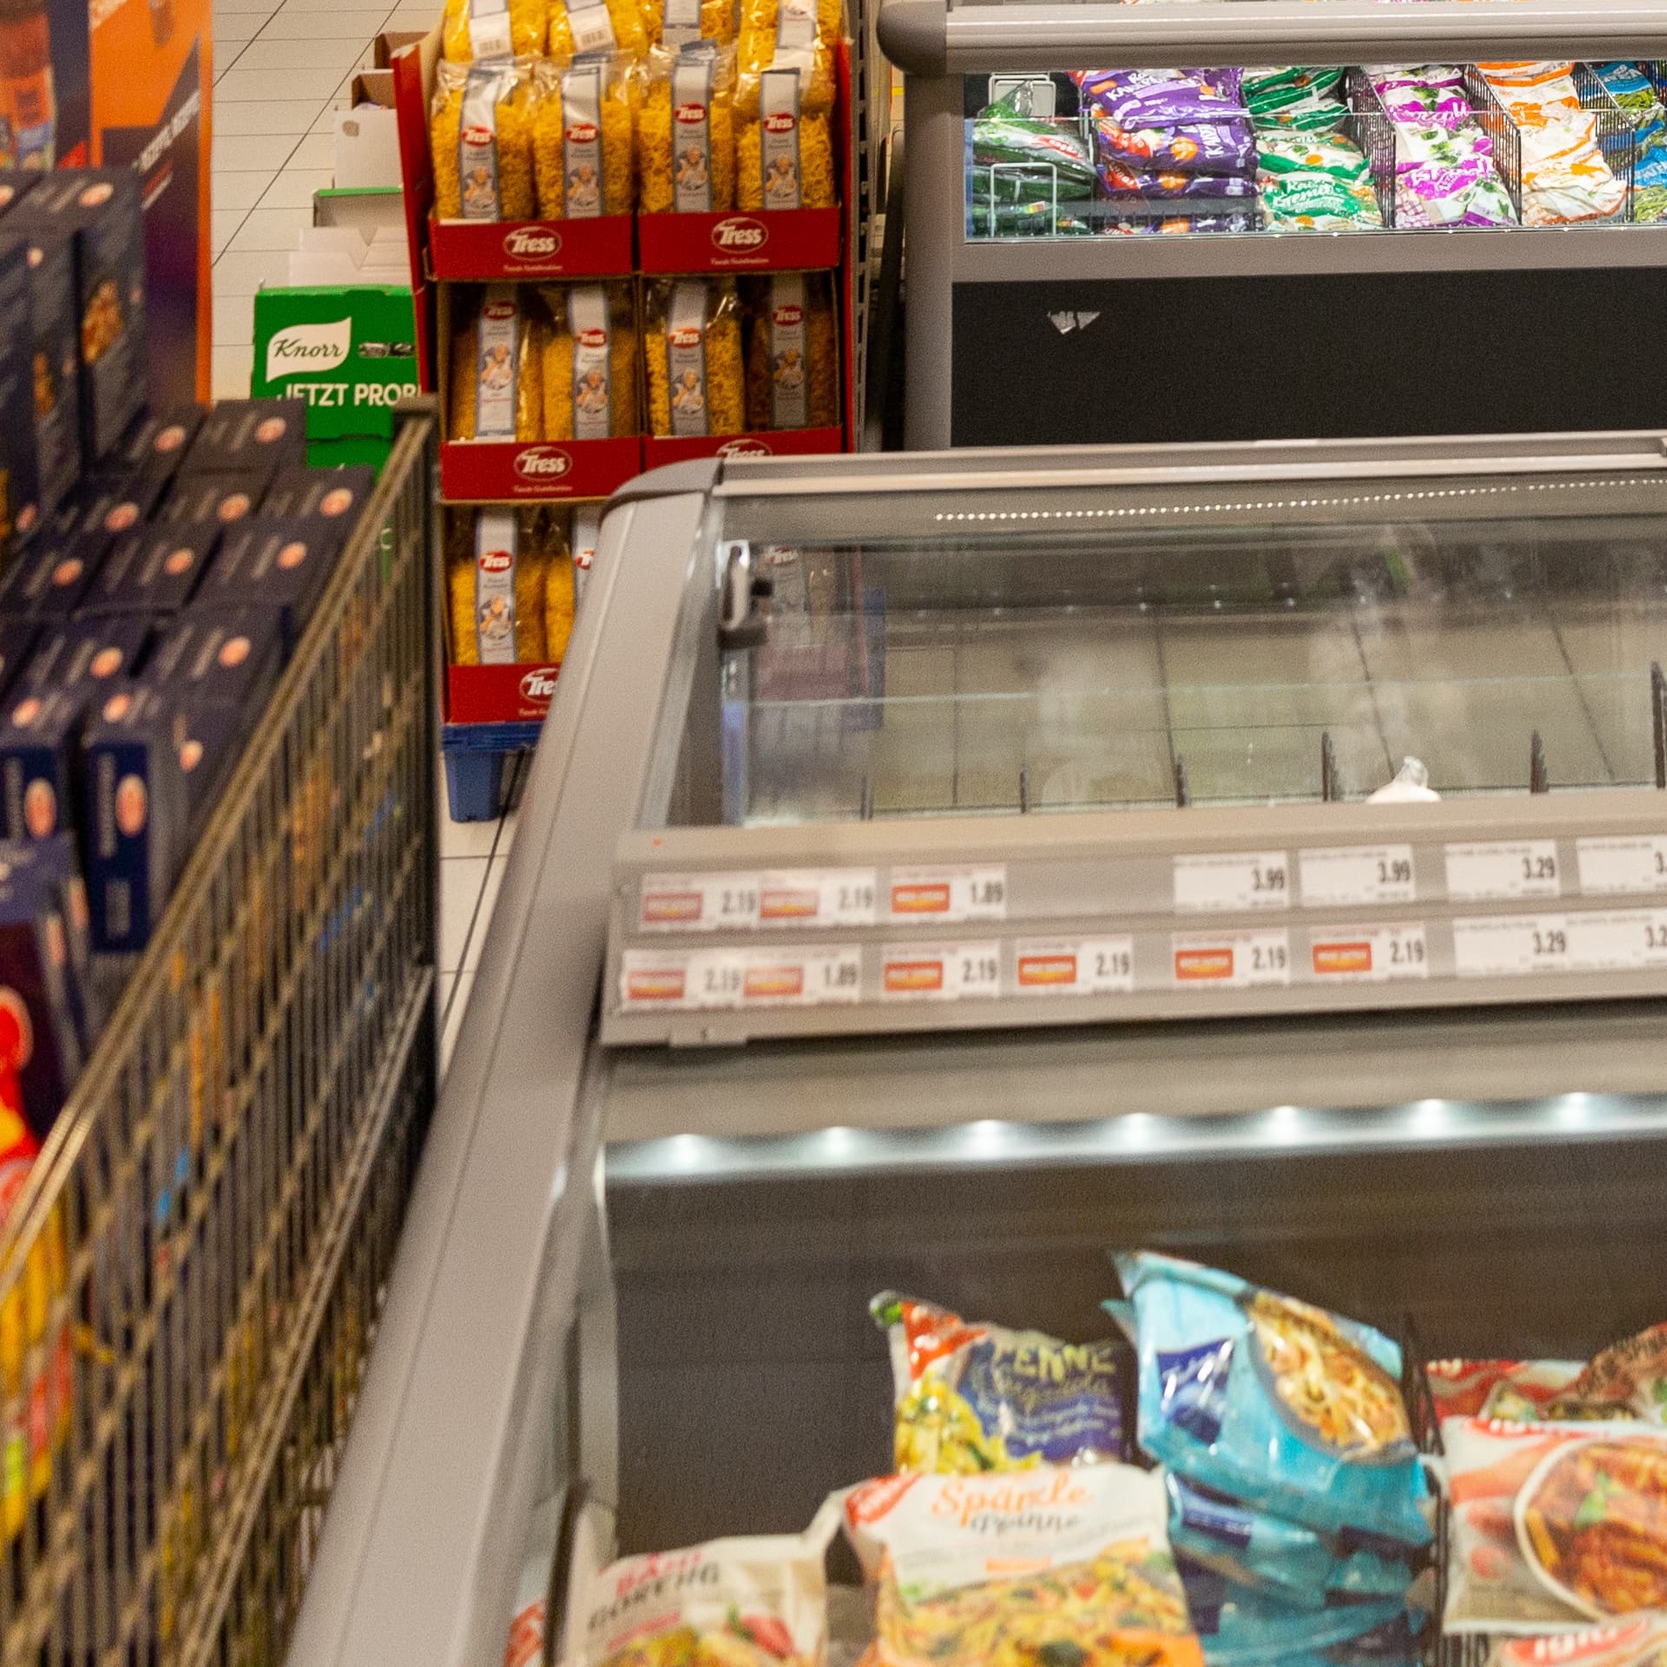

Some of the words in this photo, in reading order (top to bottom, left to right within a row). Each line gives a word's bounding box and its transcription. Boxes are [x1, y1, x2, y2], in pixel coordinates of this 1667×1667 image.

[677, 106, 705, 121] Tress
[764, 116, 794, 131] Tress
[567, 126, 597, 141] Tress
[511, 231, 556, 255] Tress
[721, 223, 763, 247] Tress
[272, 337, 346, 362] Knorr
[577, 332, 606, 346] Tress
[671, 332, 700, 346] Tress
[521, 452, 566, 476] Tress
[480, 554, 510, 570] Tress
[1251, 865, 1285, 894] 3.99
[1377, 859, 1412, 888] 3.99
[1521, 855, 1556, 881] 3.29
[1532, 930, 1567, 957] 3.29
[962, 958, 997, 984] 2.19
[1096, 952, 1131, 977] 2.19
[1252, 946, 1287, 972] 2.19
